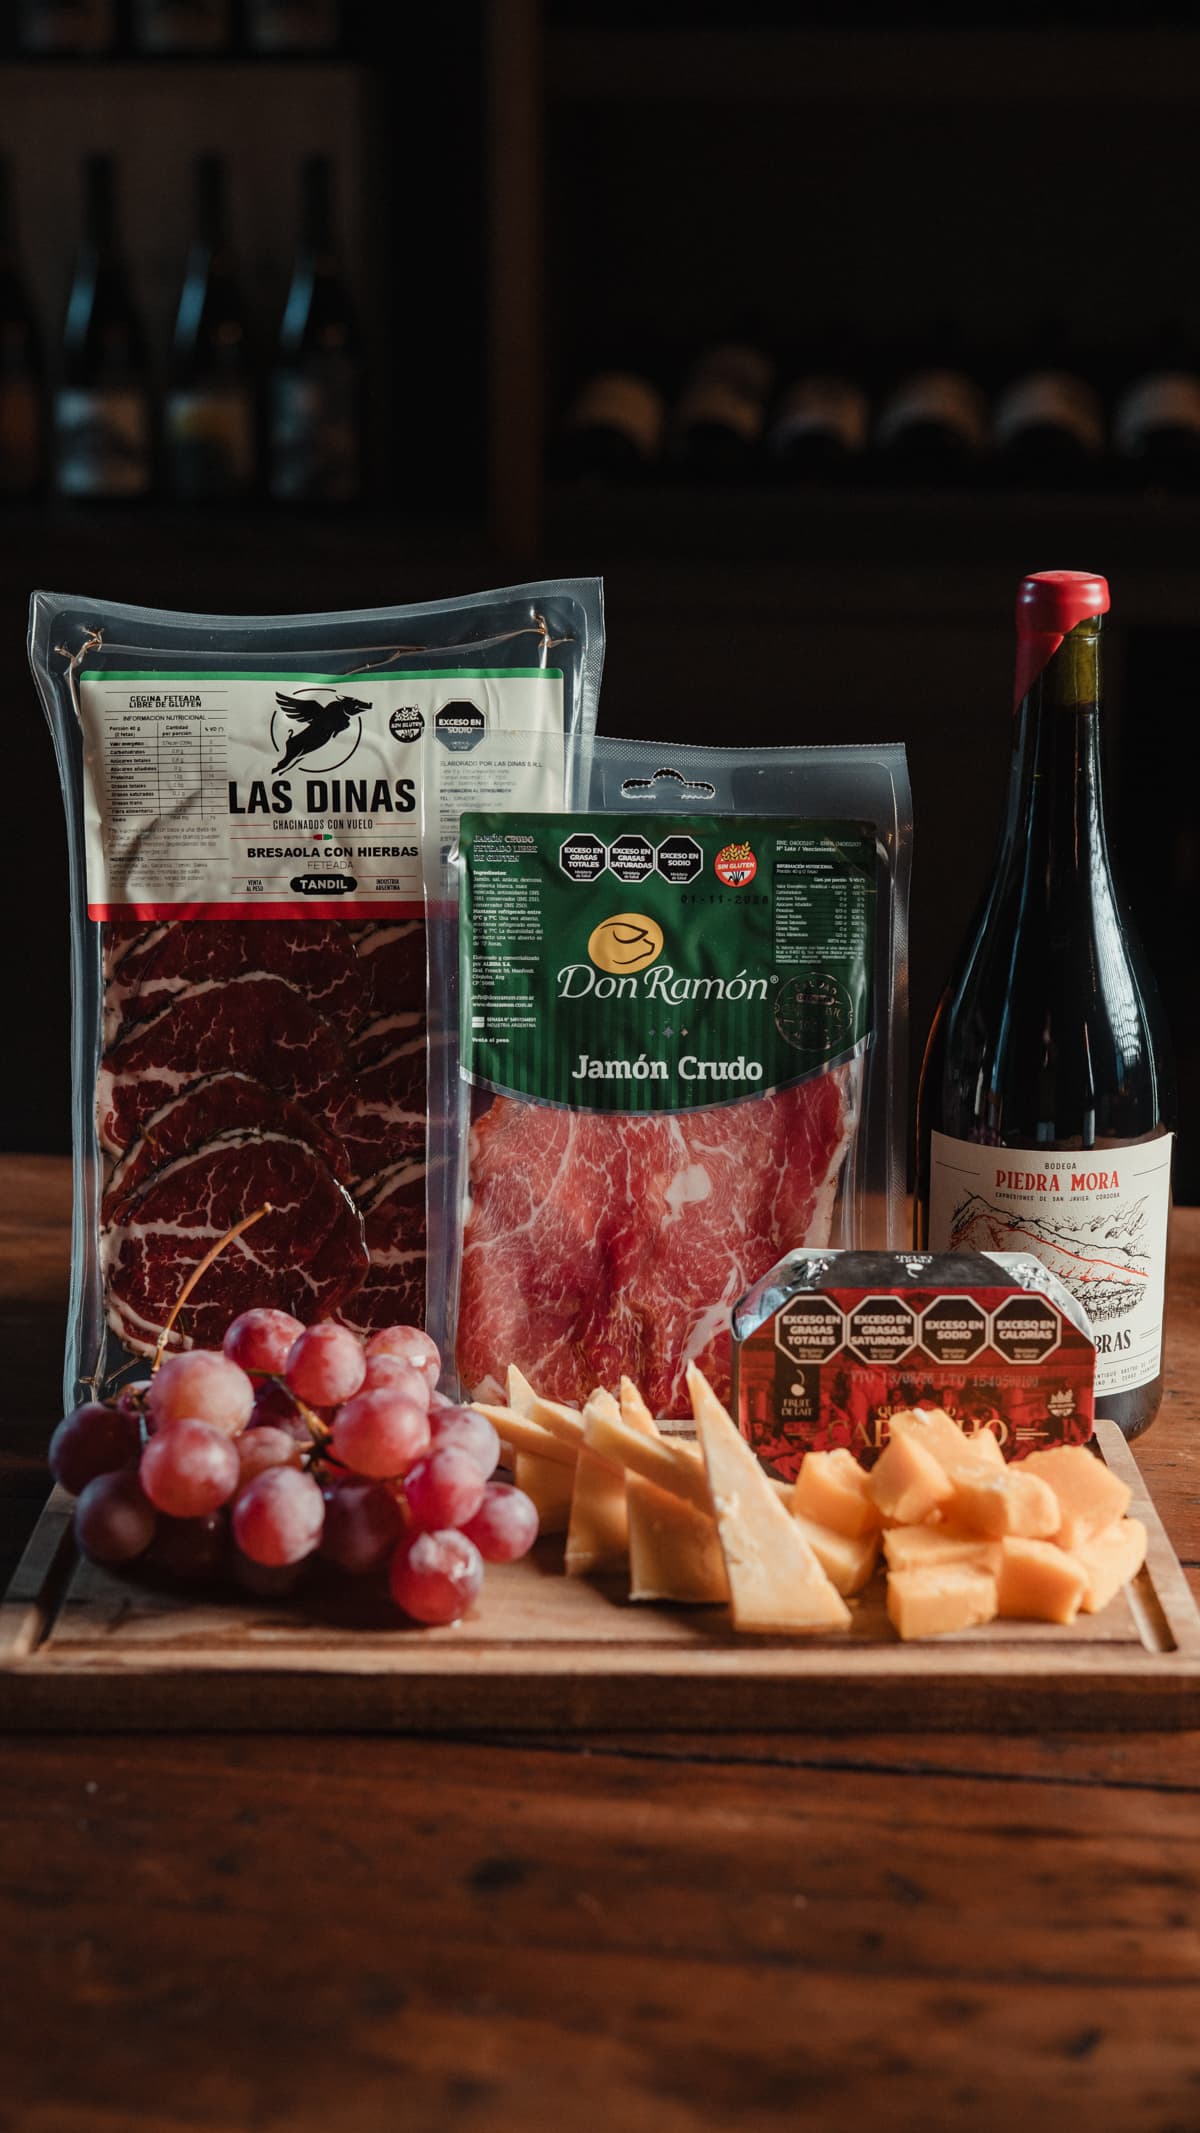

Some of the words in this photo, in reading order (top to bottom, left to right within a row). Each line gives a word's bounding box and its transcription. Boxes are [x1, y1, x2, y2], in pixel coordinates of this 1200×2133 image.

[228, 780, 293, 814] LAS
[306, 779, 416, 813] DINAS
[272, 819, 325, 830] CHACINADOS
[327, 819, 344, 830] CON
[347, 819, 373, 830] VUELO
[247, 847, 320, 858] BRESAOLA
[324, 847, 354, 858] CON
[357, 846, 419, 857] HIERBAS
[307, 860, 354, 870] FETEADA
[300, 879, 348, 890] TANDIL
[557, 964, 638, 999] Don
[571, 1053, 669, 1081] Jamón
[677, 1055, 763, 1081] Crudo
[995, 1170, 1060, 1192] PIEDRA
[1070, 1170, 1120, 1191] MORA
[782, 1315, 824, 1325] EXCESO
[825, 1315, 841, 1325] EN
[853, 1315, 896, 1325] EXCESO
[896, 1315, 912, 1325] EN
[924, 1320, 967, 1330] EXCESO
[968, 1320, 984, 1330] EN
[996, 1320, 1039, 1330] EXCESO
[1040, 1320, 1056, 1330] EN
[790, 1325, 834, 1335] GRASAS
[861, 1325, 905, 1335] GRASAS
[936, 1330, 972, 1340] SODIO
[999, 1329, 1053, 1340] CALORÍAS
[787, 1335, 836, 1345] TOTALES
[850, 1335, 913, 1346] SATURADAS
[1094, 1329, 1131, 1354] BRAS
[781, 1407, 792, 1417] DE
